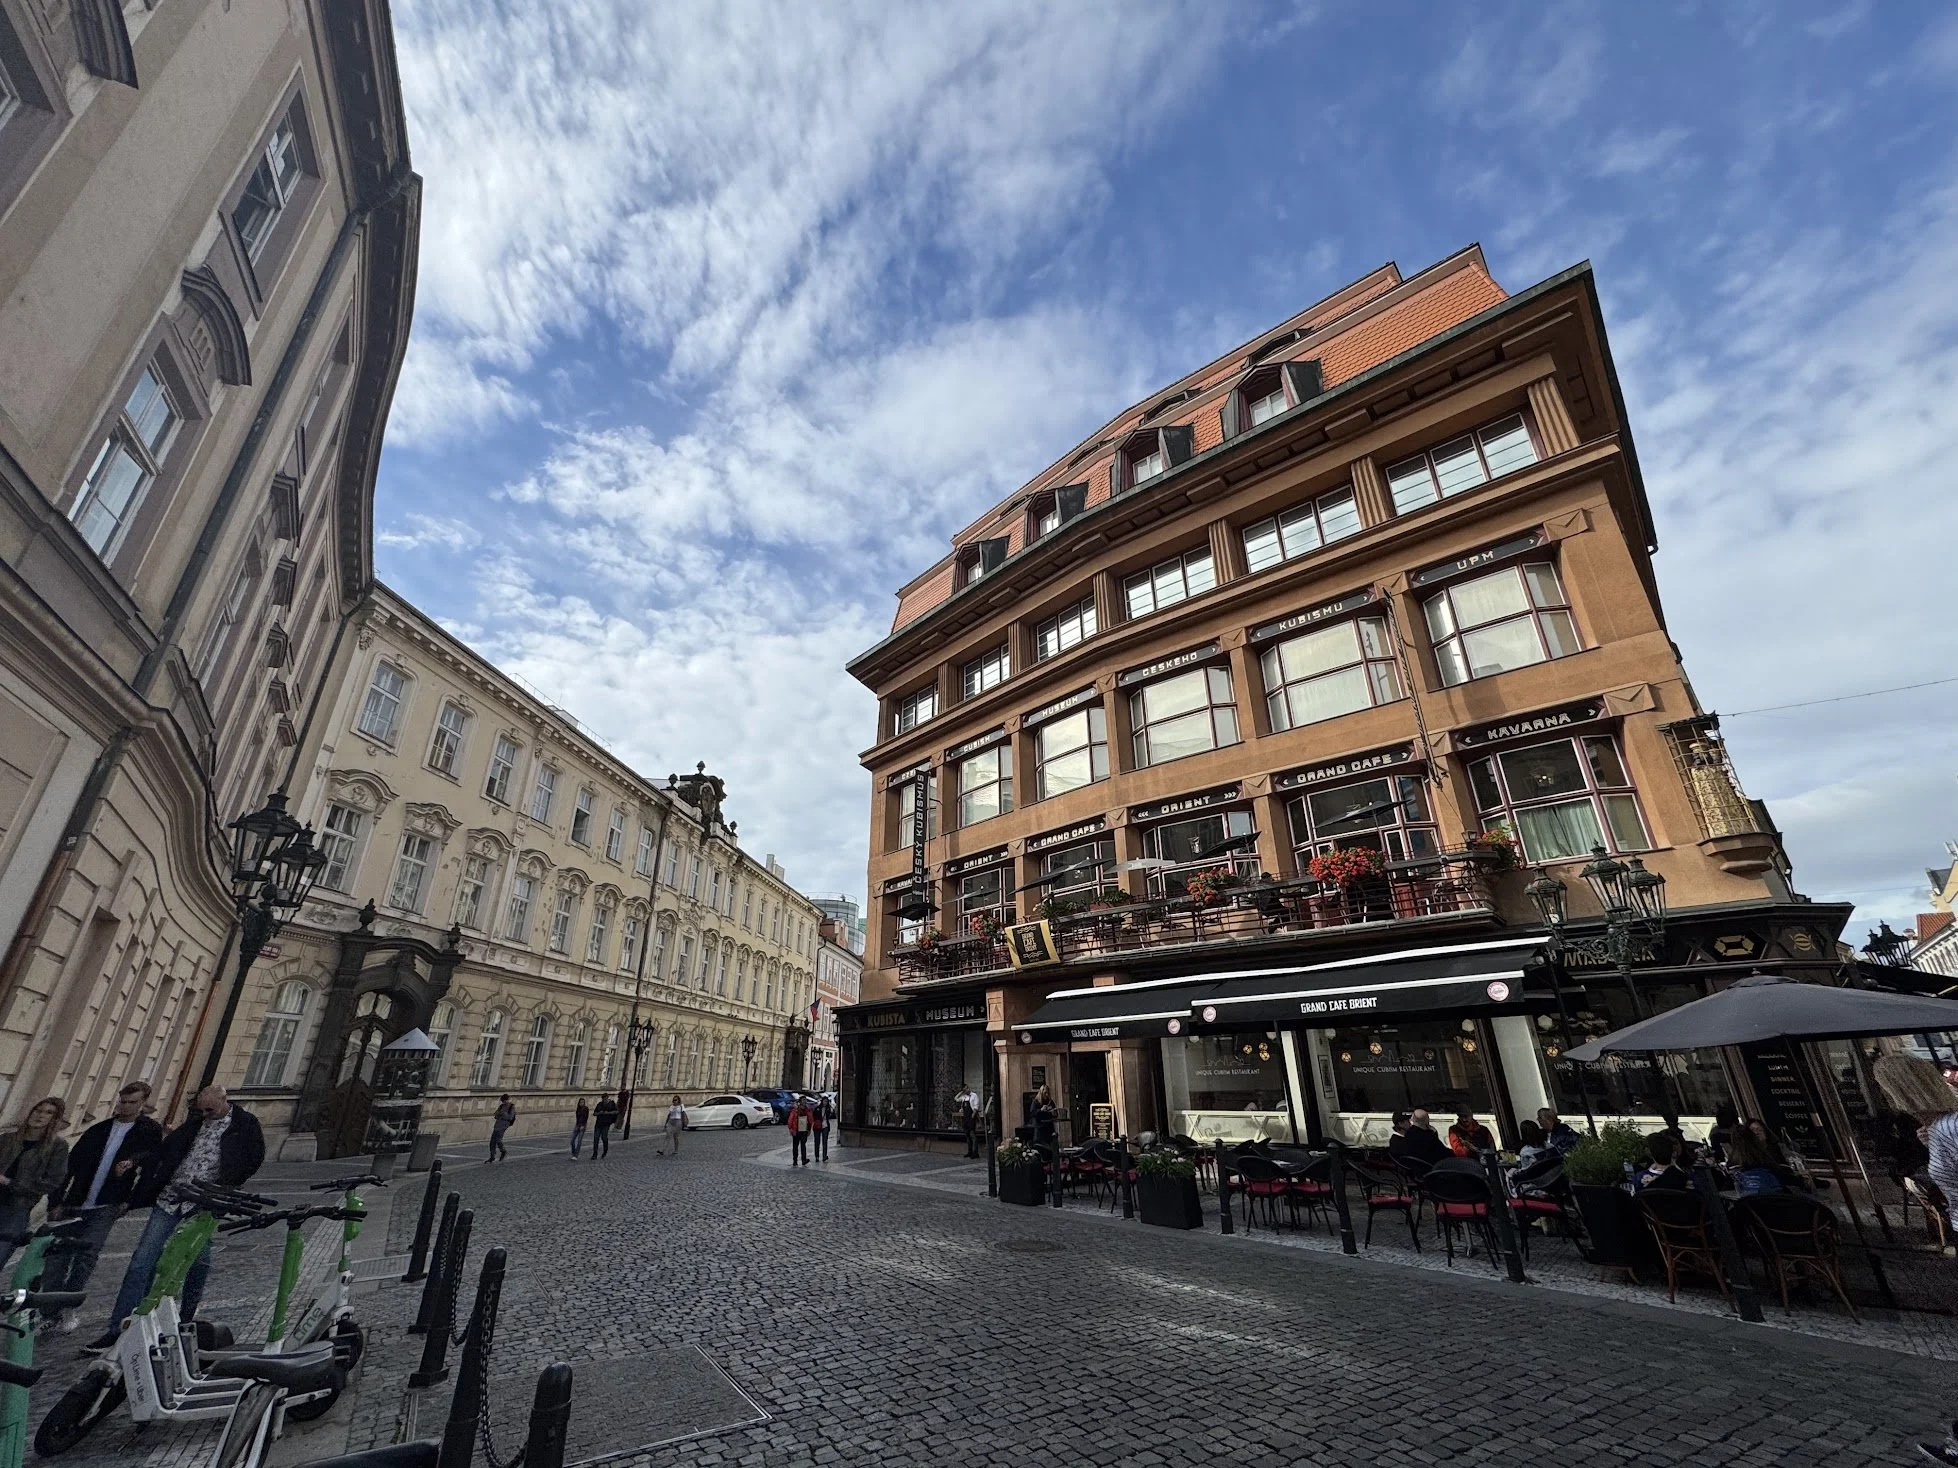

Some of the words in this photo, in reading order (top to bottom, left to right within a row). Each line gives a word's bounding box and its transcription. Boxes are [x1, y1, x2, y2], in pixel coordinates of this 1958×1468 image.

[1456, 550, 1494, 570] UPM
[1278, 602, 1343, 631] KUBISMU
[1042, 695, 1079, 717] MUSEUM
[1296, 764, 1346, 784] GRAND
[1350, 753, 1392, 772] CAFE
[914, 774, 925, 837] KUBISMUS
[1161, 795, 1211, 814] ORIENT
[1040, 831, 1070, 847] GRAND
[1071, 824, 1096, 838] CAFE
[963, 854, 993, 869] ORIENT
[926, 1006, 975, 1021] MUSEUM
[1301, 1002, 1327, 1013] GRAND
[1328, 1000, 1348, 1011] CAFE
[1348, 997, 1378, 1009] ORIENT
[867, 1012, 906, 1028] KUBISTA
[1353, 1066, 1375, 1074] UNIQUE
